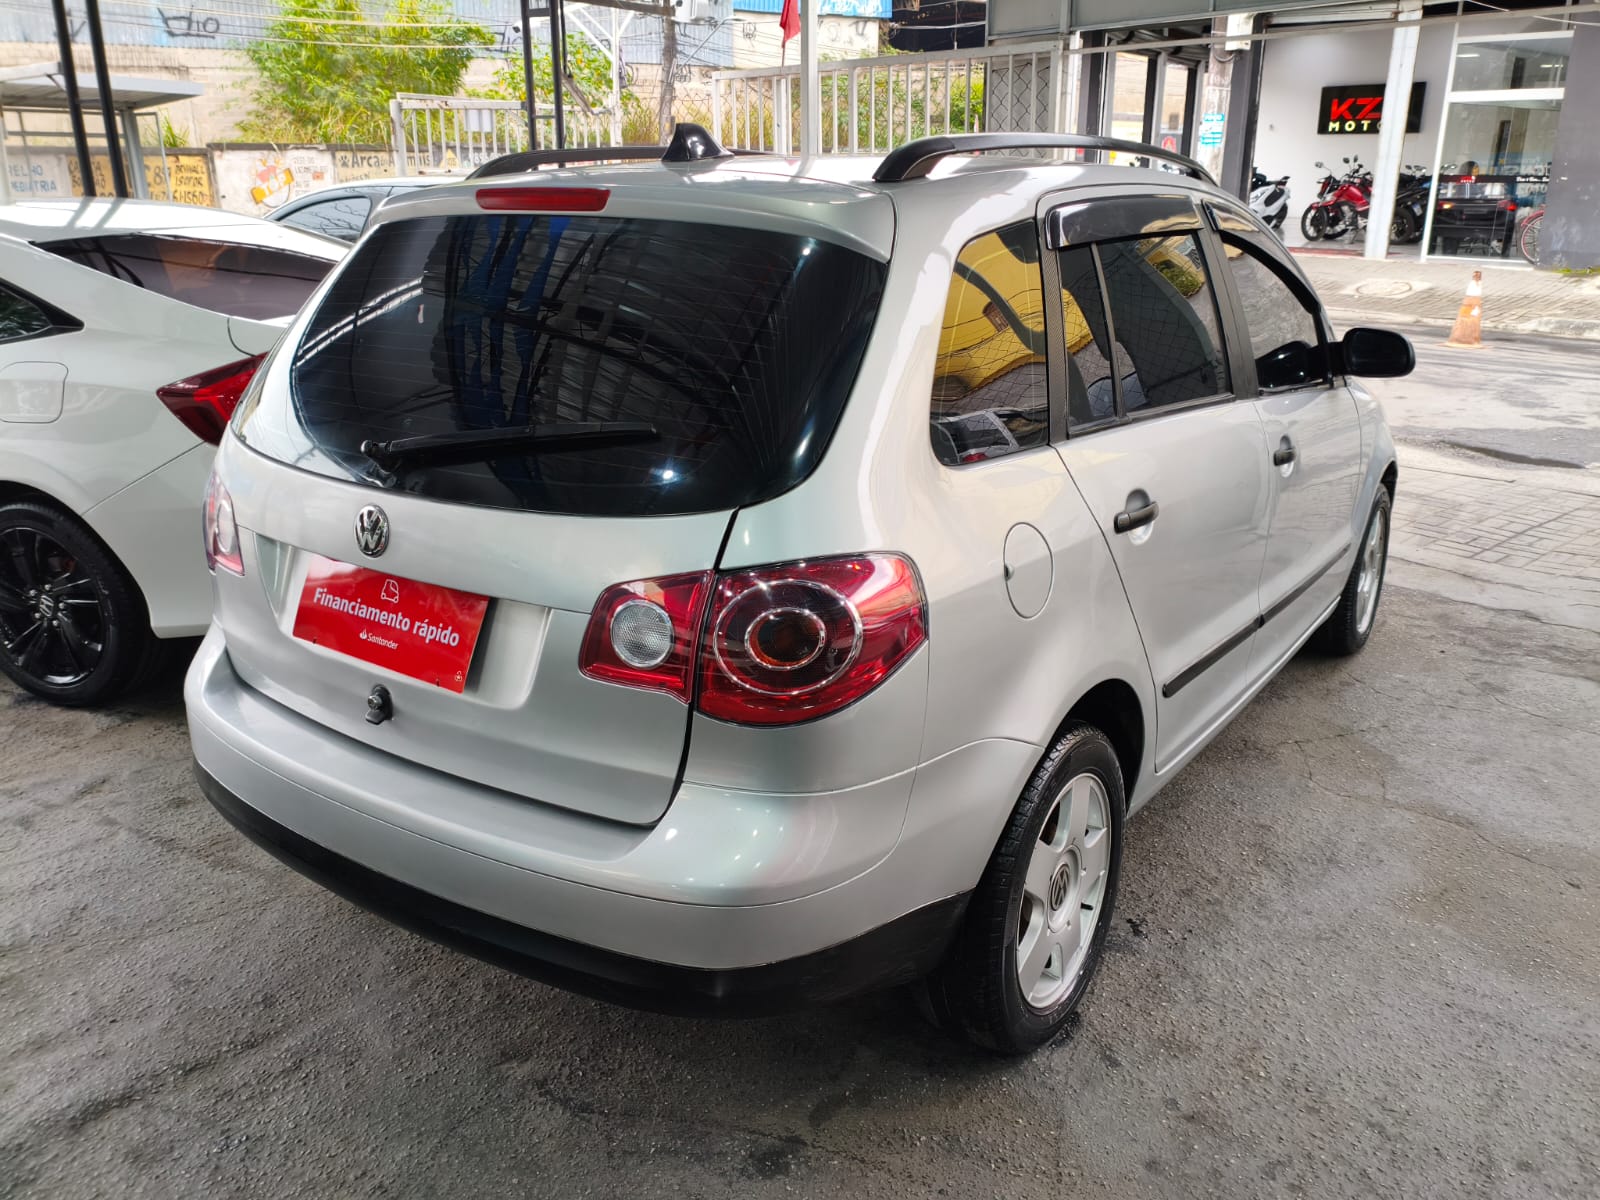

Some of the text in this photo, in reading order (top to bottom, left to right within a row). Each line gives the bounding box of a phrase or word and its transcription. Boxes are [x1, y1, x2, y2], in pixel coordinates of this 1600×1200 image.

[351, 153, 380, 168] Arca
[313, 588, 460, 647] Financiamento rápido
[367, 633, 399, 650] Santander
